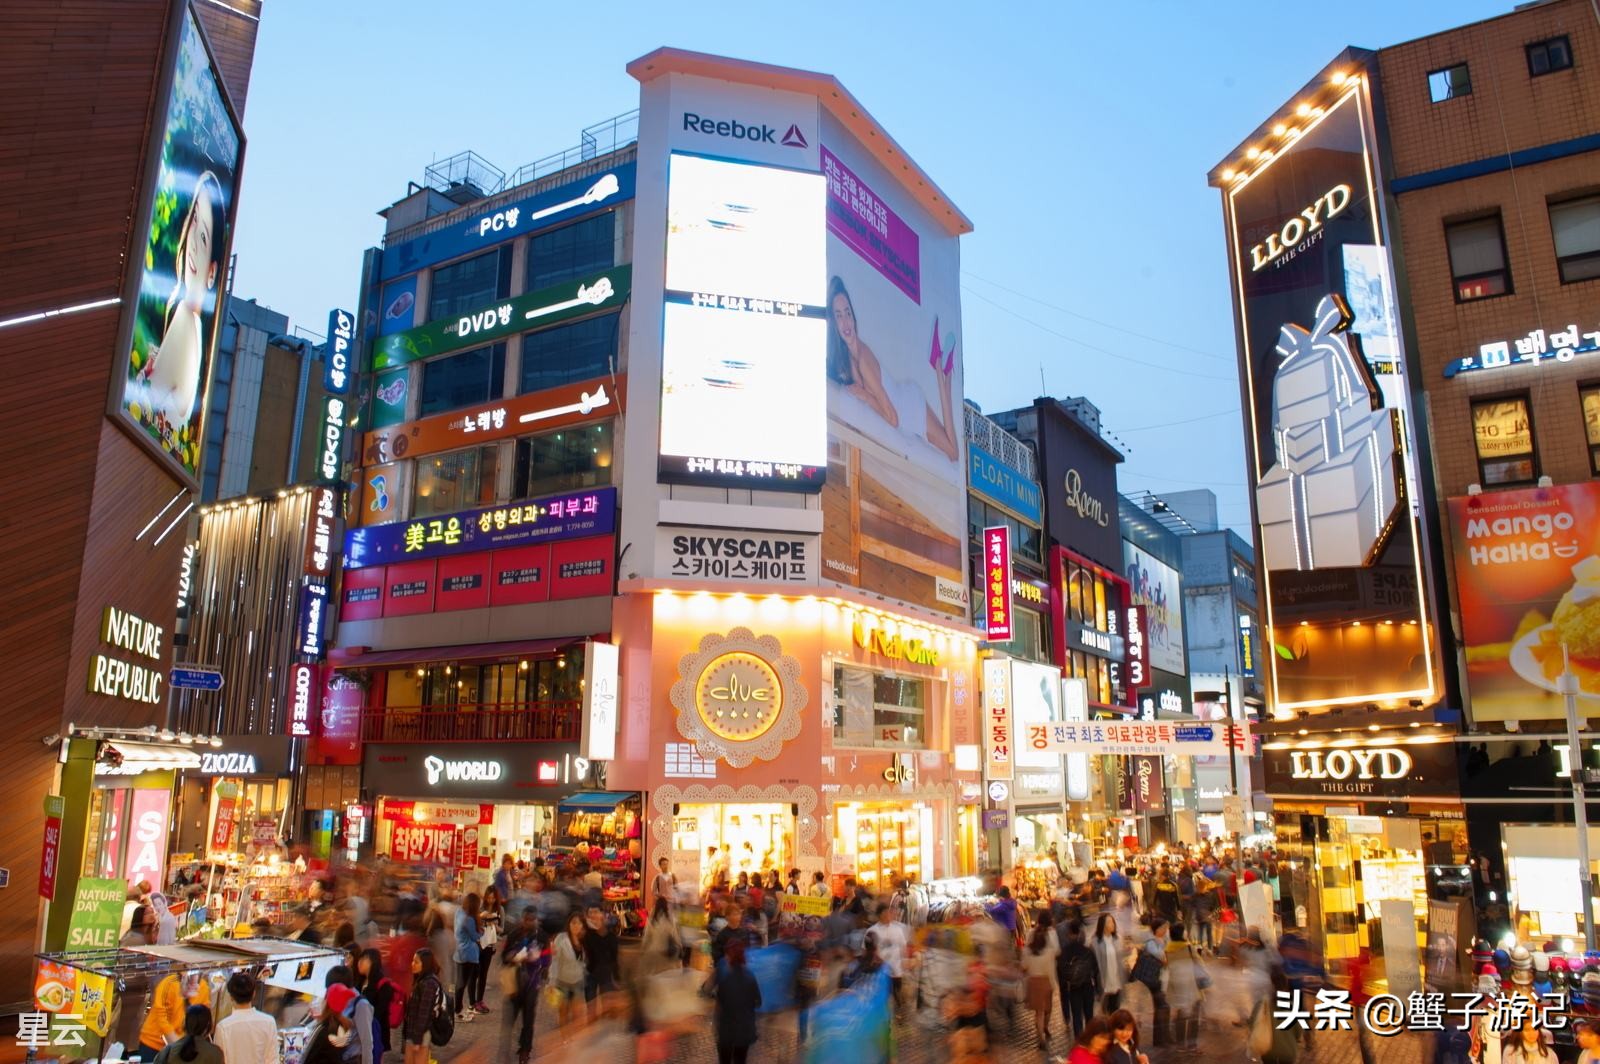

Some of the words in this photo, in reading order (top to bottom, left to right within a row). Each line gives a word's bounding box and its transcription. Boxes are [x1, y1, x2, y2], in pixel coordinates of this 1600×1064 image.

[683, 111, 776, 145] Reebok
[480, 207, 520, 237] PC방
[1250, 183, 1352, 272] LLOYD
[1274, 248, 1298, 270] THE
[1298, 228, 1324, 254] GIFT
[458, 304, 513, 336] DVD방
[464, 407, 507, 433] 노래방
[1064, 468, 1109, 528] Roem
[1467, 501, 1521, 515] Sensational
[1523, 497, 1560, 511] Dessert
[1467, 511, 1574, 539] Mango
[673, 535, 806, 561] SKYSCAPE
[1470, 541, 1551, 566] HaHa
[671, 557, 807, 581] 스카이스케이프
[938, 583, 962, 601] Reebok
[106, 606, 163, 660] NATURE
[93, 655, 163, 705] REPUBLIC
[709, 672, 770, 702] clue
[294, 666, 311, 721] COFFEE
[1030, 725, 1048, 750] 경
[1054, 726, 1077, 744] 전국
[1081, 725, 1105, 744] 최초
[1107, 725, 1171, 745] 의료관광특
[201, 752, 257, 774] ZIOZIA
[445, 760, 501, 781] WORLD
[1291, 748, 1412, 780] LLOYD
[1138, 758, 1153, 803] Roem
[1320, 782, 1344, 793] THE
[1346, 782, 1374, 793] GIFT
[219, 808, 231, 821] SALE
[45, 828, 58, 846] SALE
[76, 901, 100, 913] DAY
[78, 889, 122, 902] NATURE
[69, 927, 116, 947] SALE
